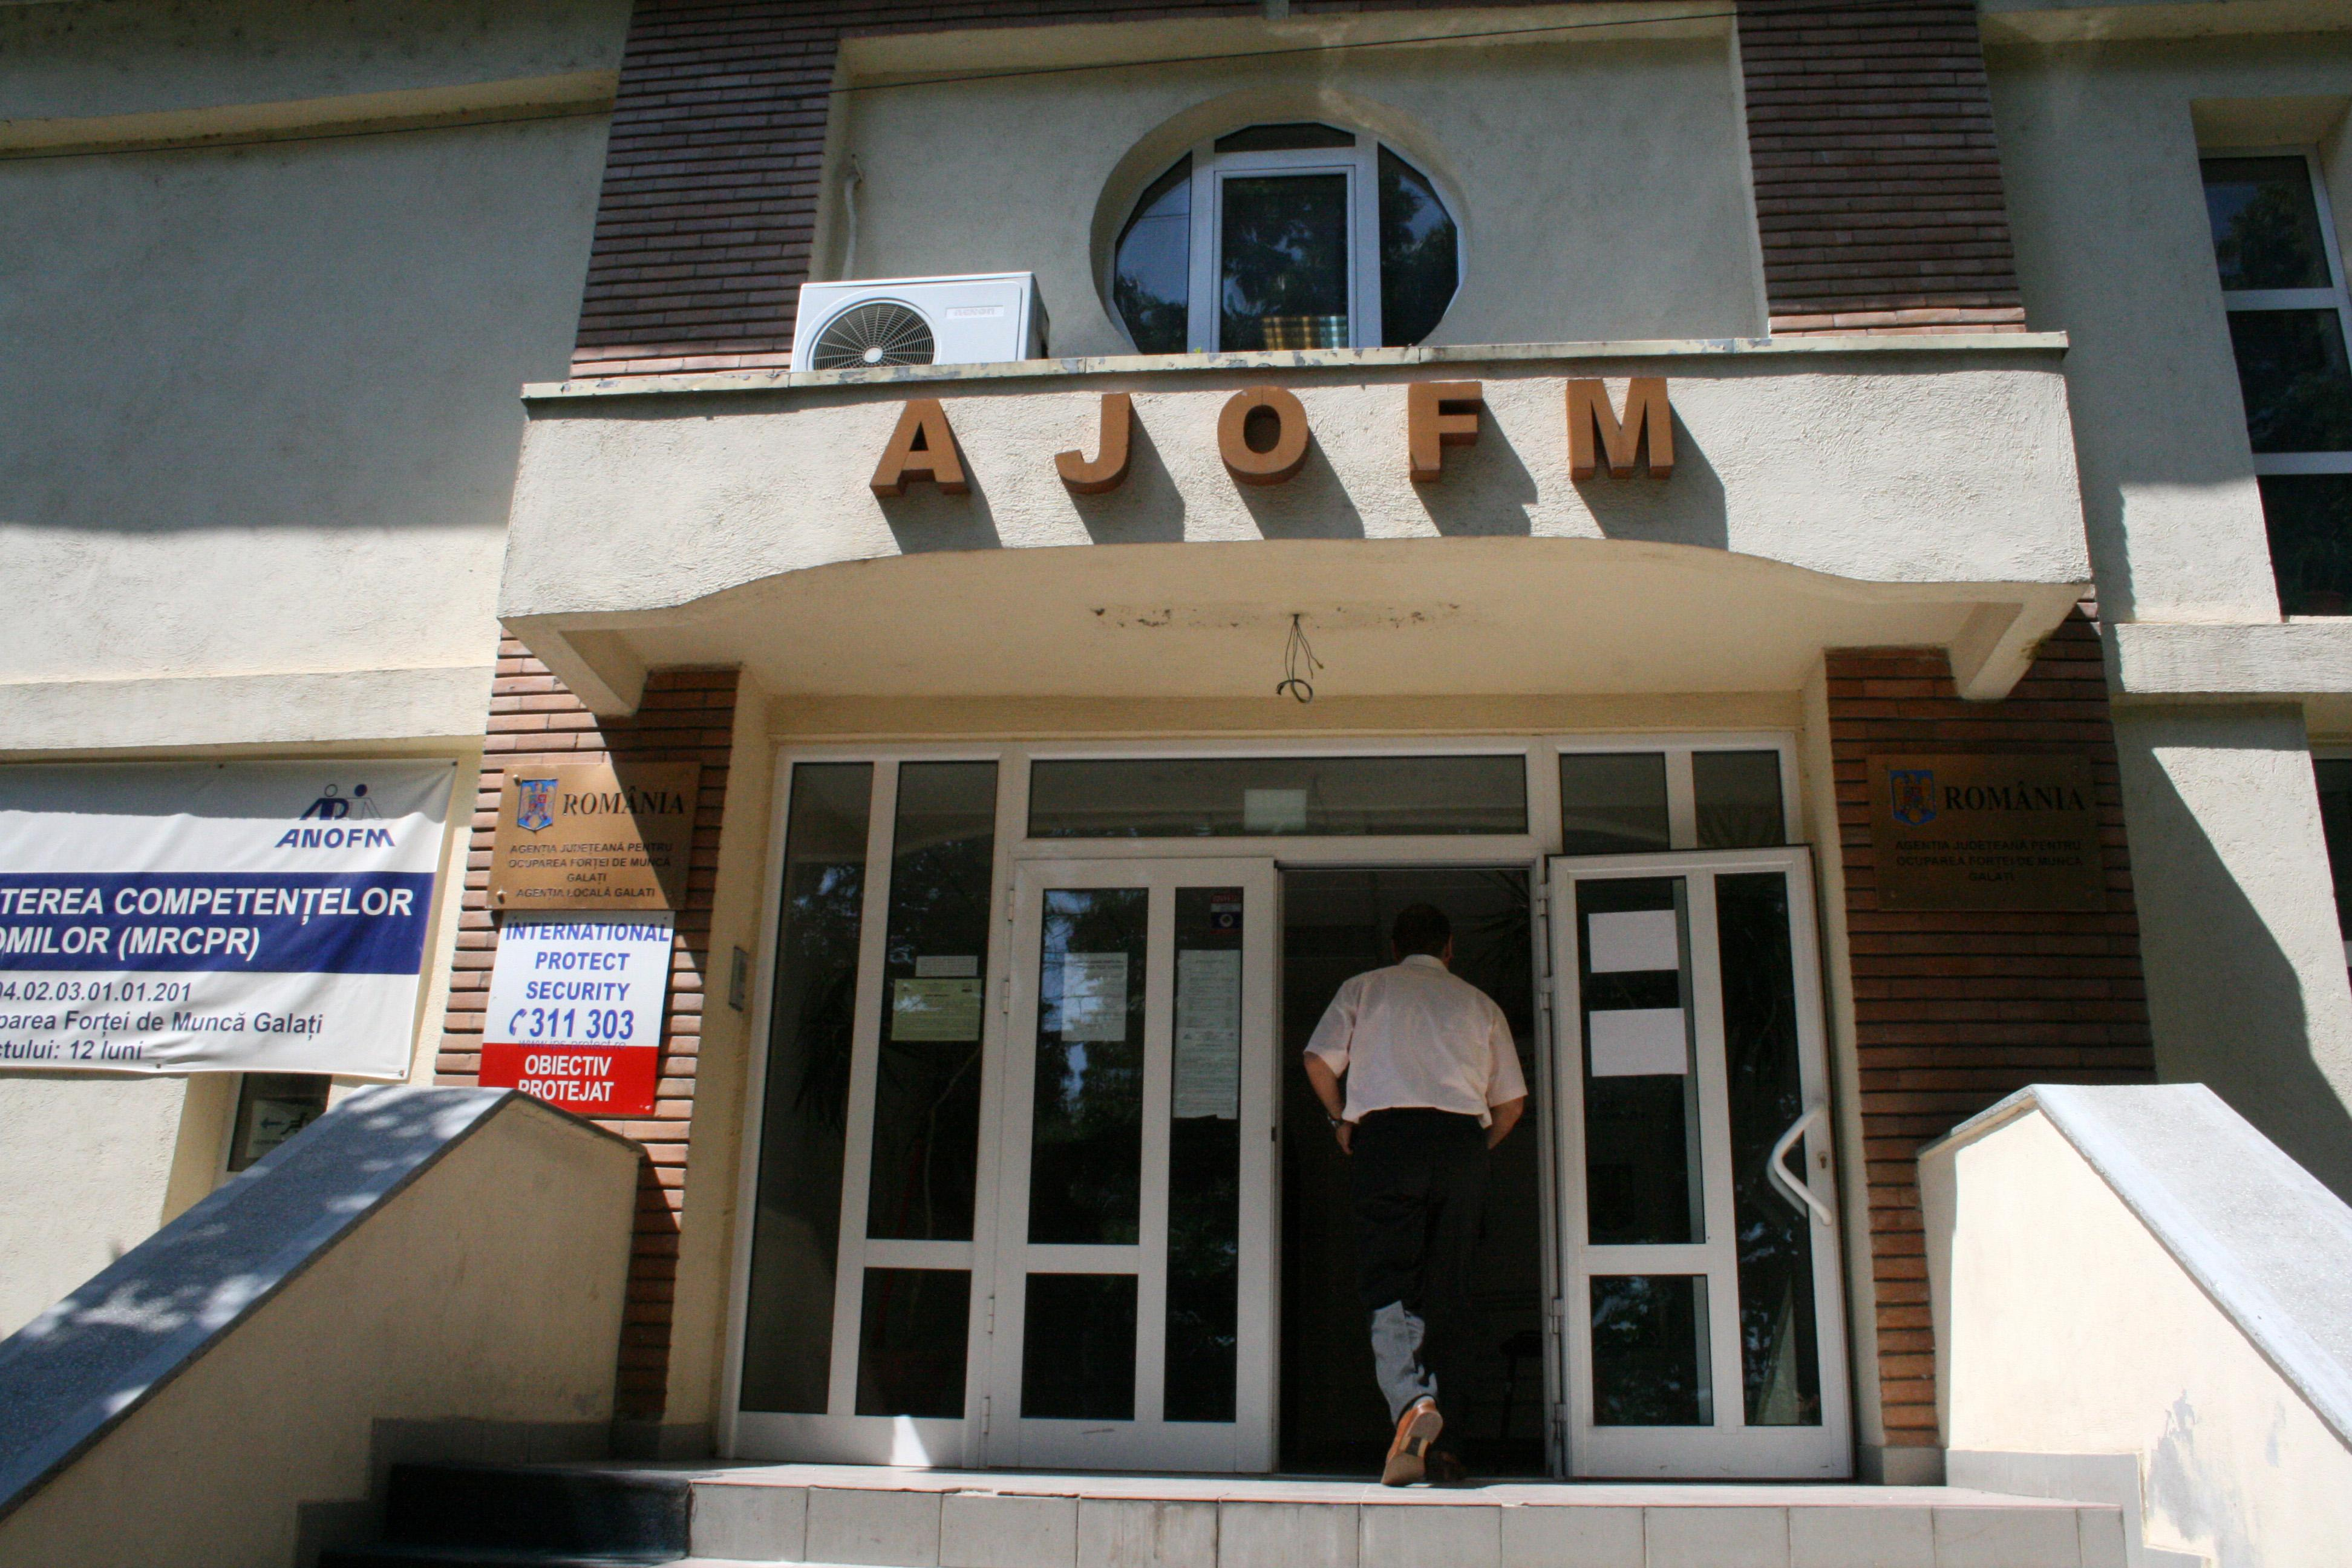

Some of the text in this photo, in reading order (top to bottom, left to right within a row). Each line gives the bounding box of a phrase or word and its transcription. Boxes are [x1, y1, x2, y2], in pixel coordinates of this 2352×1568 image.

[870, 377, 1675, 496] AJOFM
[563, 786, 684, 815] ROMÂNIA
[1944, 780, 2085, 811] ROMÂNIA
[274, 828, 395, 848] ANOFM
[627, 843, 673, 852] PENTRU
[509, 858, 567, 867] OCUPAREA
[612, 858, 627, 866] DE
[567, 873, 607, 885] GALAȚI
[0, 887, 414, 926] TEREA COMPETENȚELOR
[506, 923, 670, 941] INTERNATIONAL
[118, 927, 260, 962] (MRCPR)
[535, 952, 630, 971] PROTECT
[0, 981, 192, 1002] 4.02.03.01.01.201
[526, 981, 630, 1001] SECURITY
[65, 1010, 131, 1037] Forței
[136, 1011, 164, 1031] de
[172, 1011, 246, 1033] Muncă
[254, 1011, 323, 1041] Galați
[529, 1008, 635, 1039] 311 303
[0, 1039, 144, 1060] tului: 12 luni
[524, 1054, 612, 1076] OBIECTIV
[518, 1079, 615, 1102] PROTEJAT
